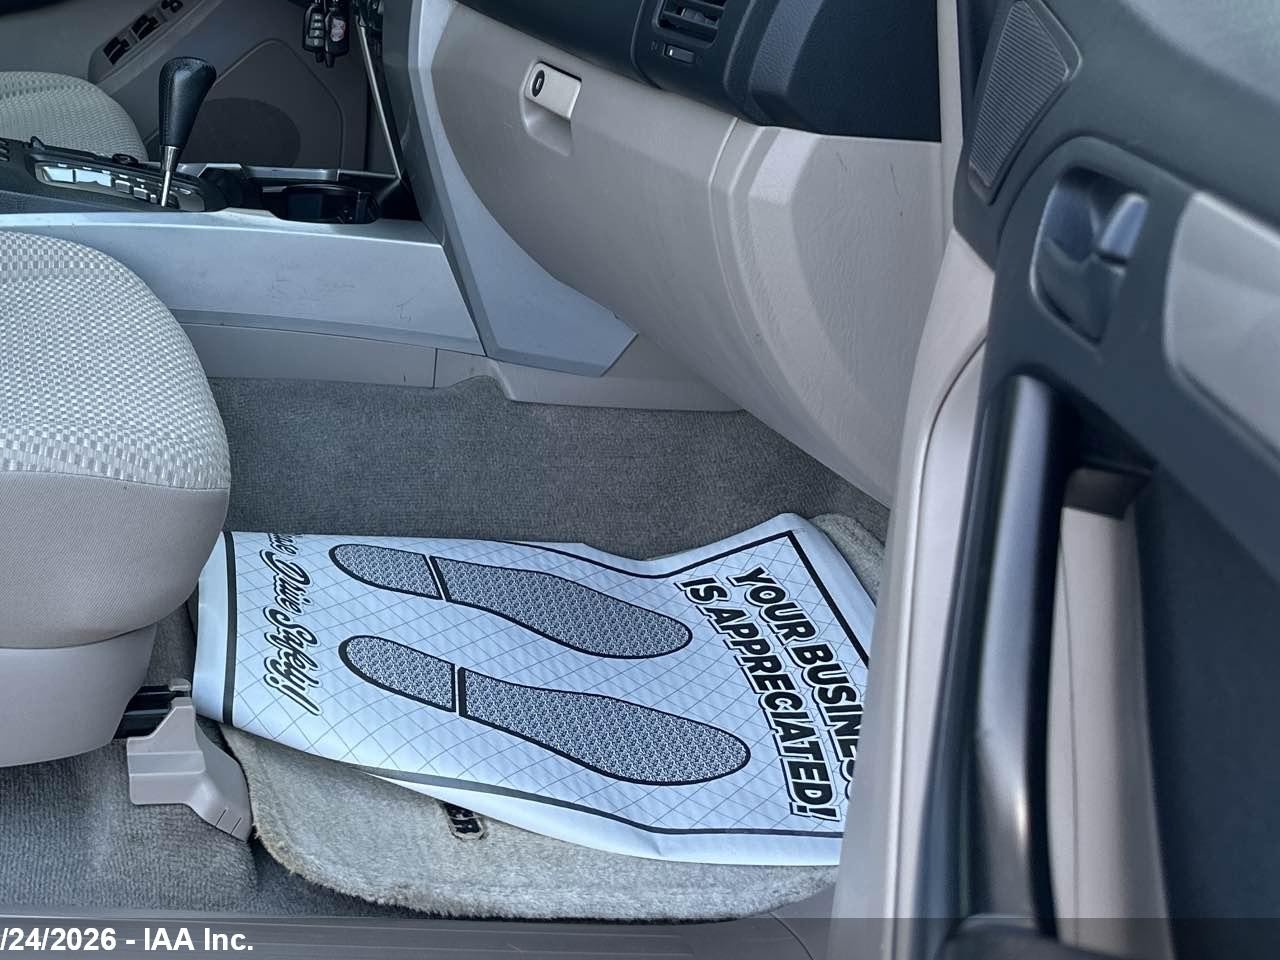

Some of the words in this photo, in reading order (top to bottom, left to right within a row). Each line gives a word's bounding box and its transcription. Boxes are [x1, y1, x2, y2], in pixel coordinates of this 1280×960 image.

[261, 549, 312, 615] Drive
[674, 574, 731, 604] IS
[263, 606, 321, 716] Safely!
[696, 604, 841, 821] APPRECIATED!
[727, 566, 816, 645] YOUR
[785, 643, 863, 800] BUSINE
